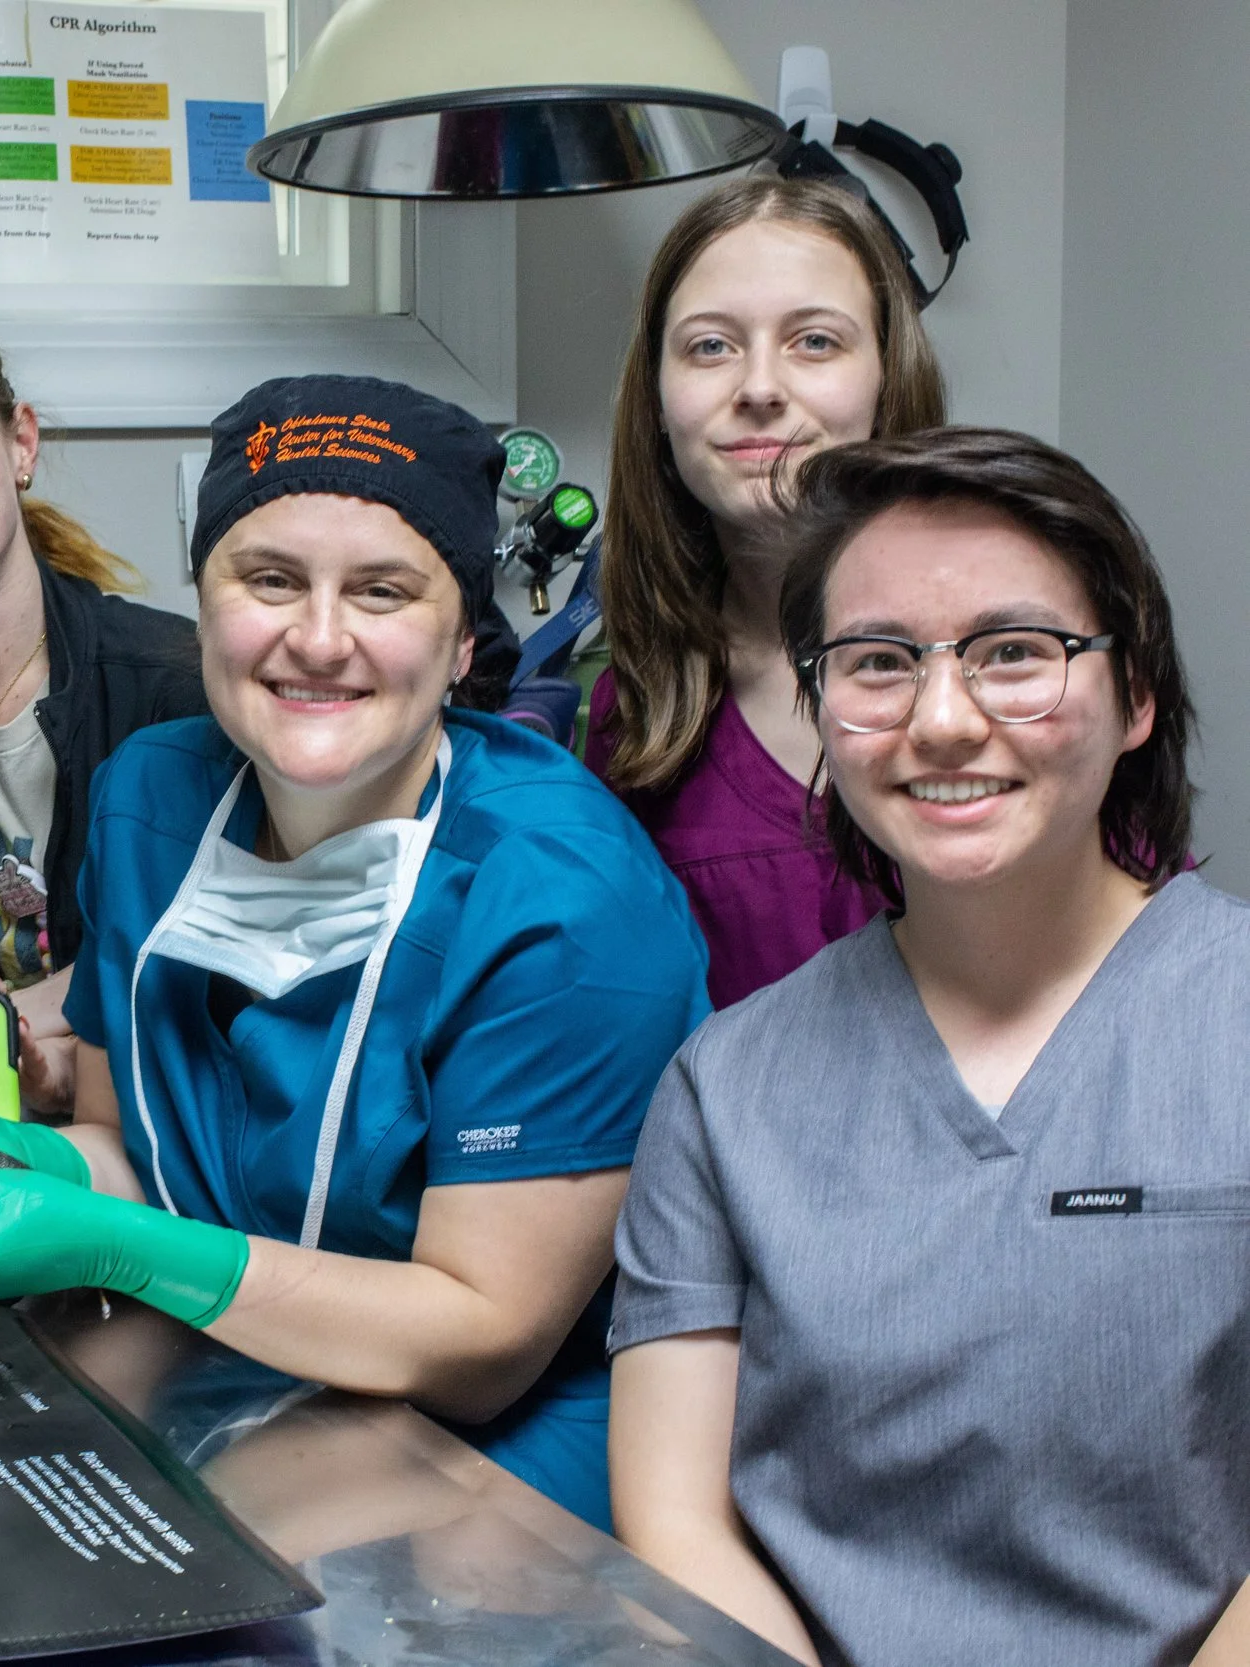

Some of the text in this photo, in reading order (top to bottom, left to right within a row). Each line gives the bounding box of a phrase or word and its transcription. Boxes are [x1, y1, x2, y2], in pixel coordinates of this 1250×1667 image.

[49, 16, 157, 35] CPR Algorithm
[38, 231, 51, 239] top
[87, 231, 112, 240] Repeat
[113, 232, 132, 240] from
[147, 234, 159, 242] top
[280, 413, 391, 433] Oklahoma State
[275, 443, 382, 464] Health Sciences
[277, 428, 418, 464] Center for Veterinary
[456, 1124, 522, 1143] CHEROKEE
[1066, 1193, 1127, 1207] JAANUU
